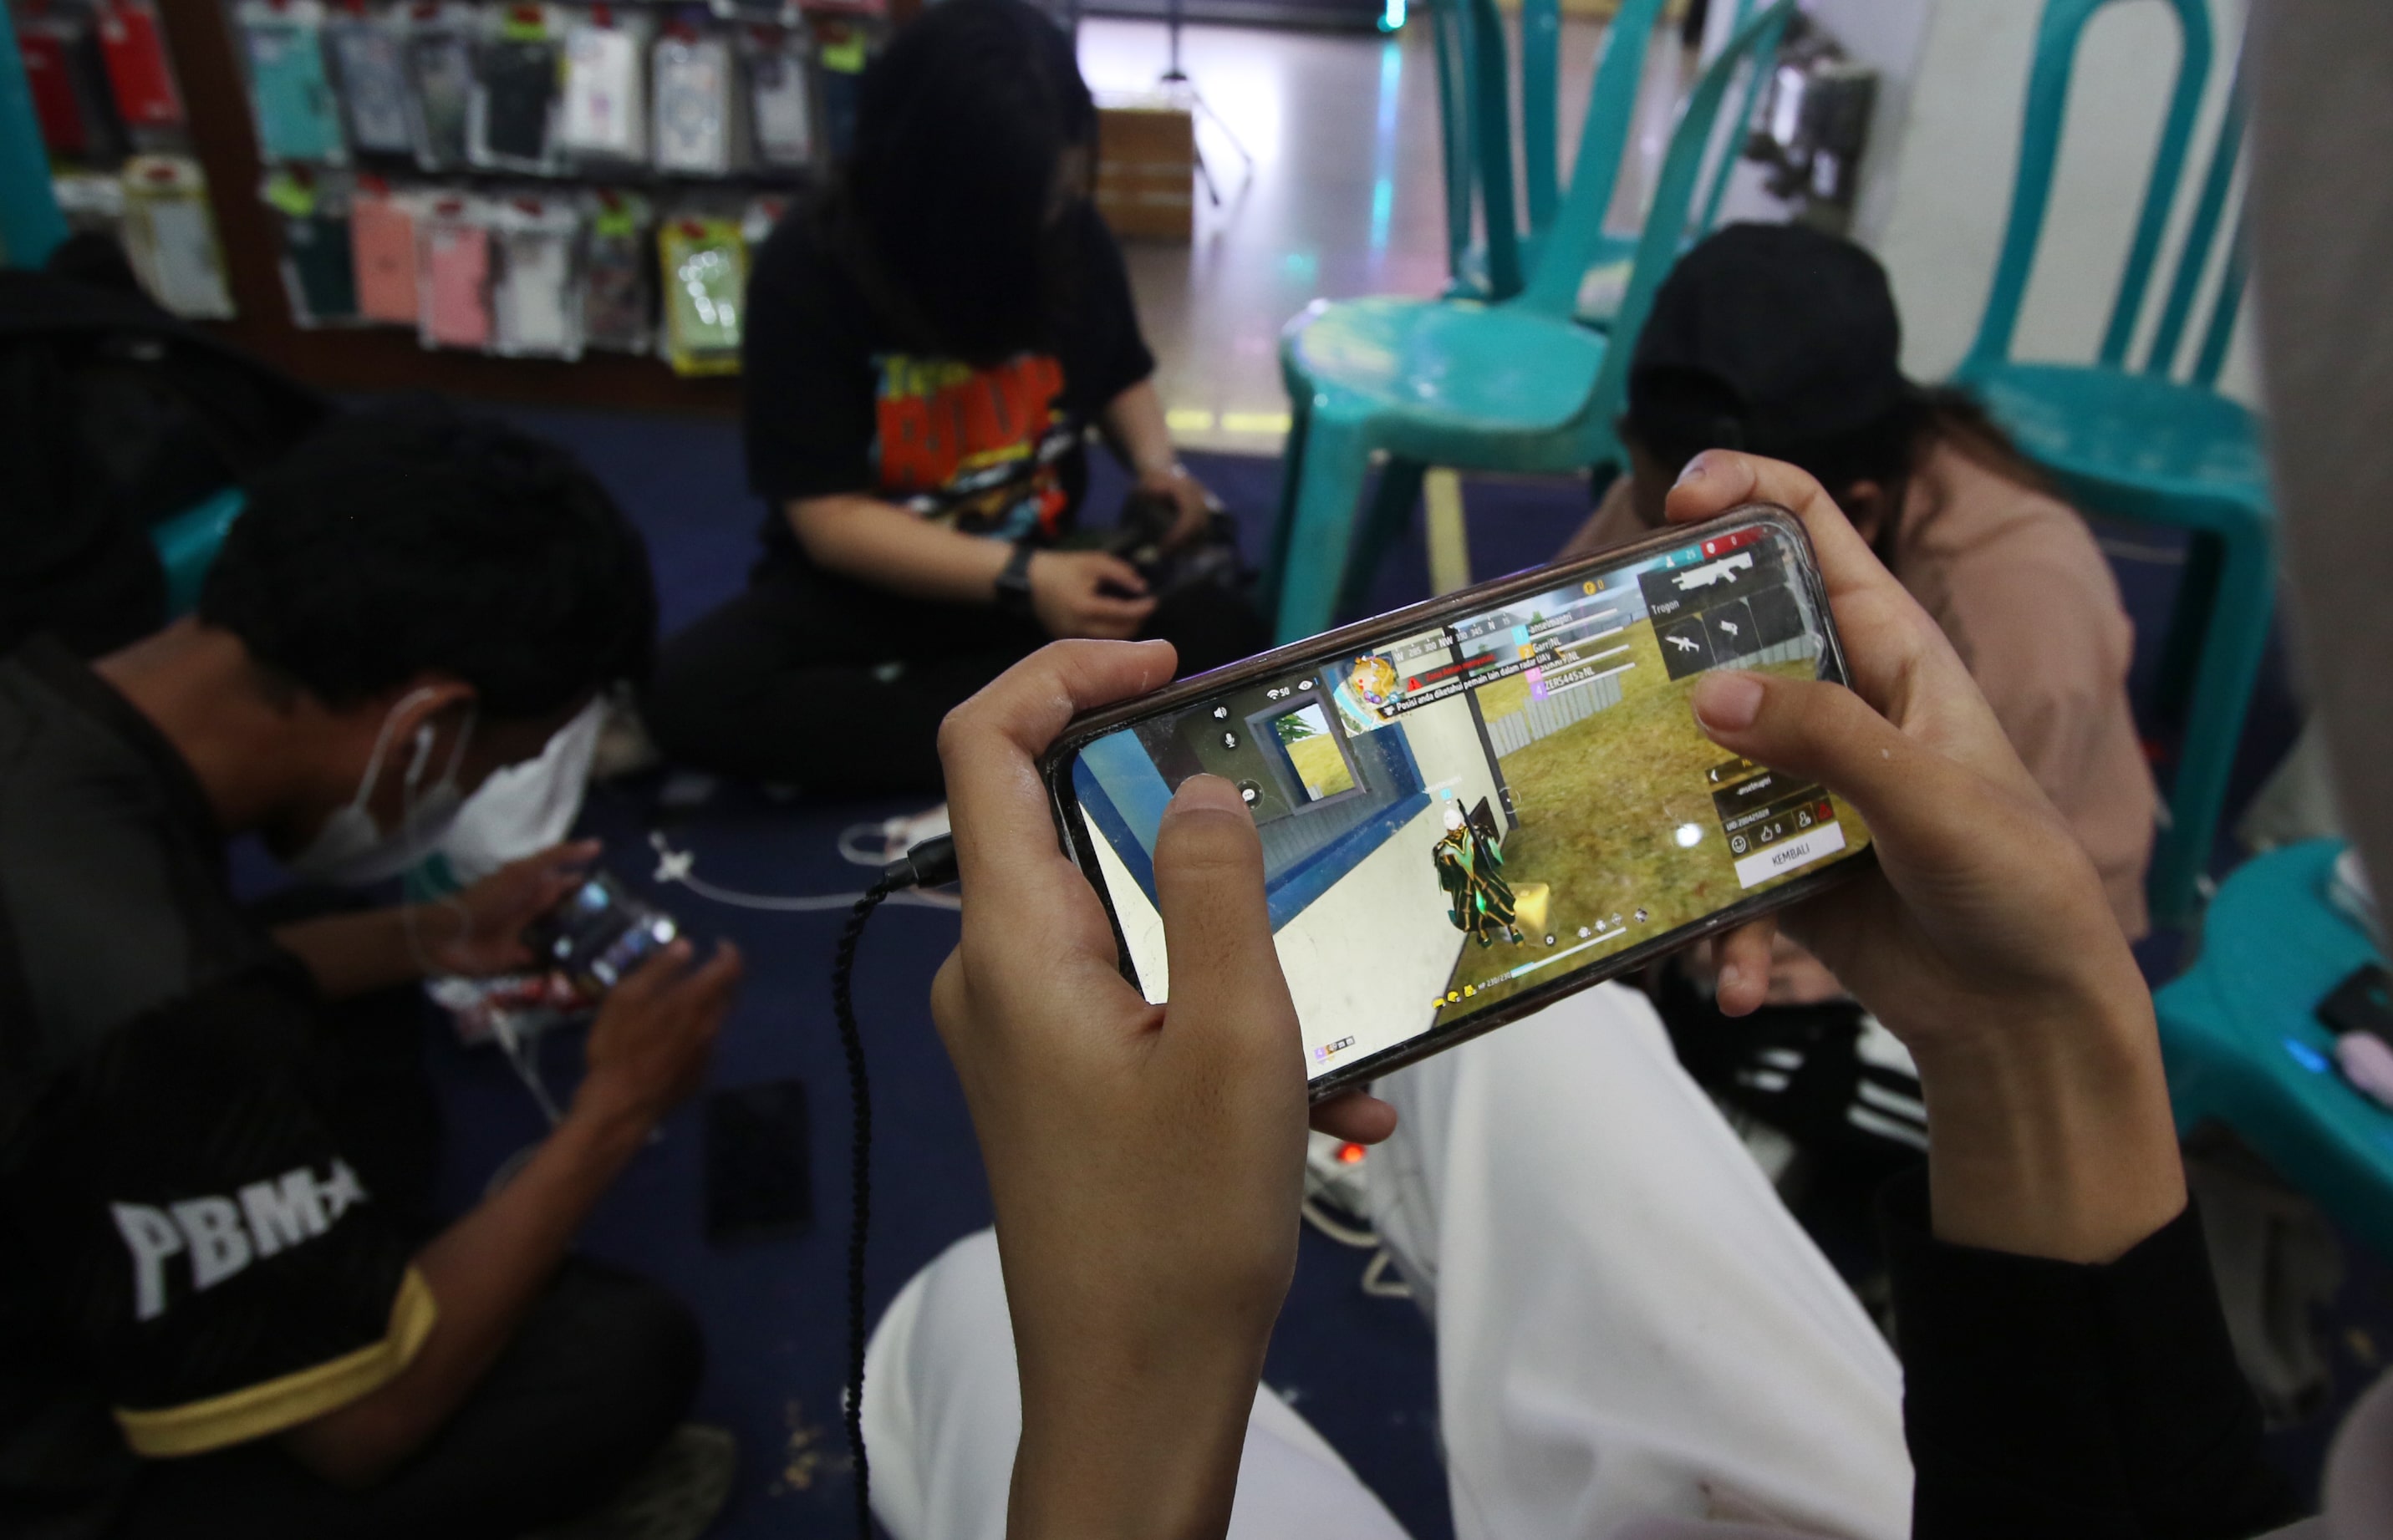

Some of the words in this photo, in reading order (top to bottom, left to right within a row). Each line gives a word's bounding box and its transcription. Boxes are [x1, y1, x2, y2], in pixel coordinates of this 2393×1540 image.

[1651, 600, 1680, 616] Trogon
[1438, 637, 1453, 650] NW
[1488, 620, 1495, 631] N
[1397, 696, 1418, 711] Posisi
[1418, 693, 1433, 705] anda
[1434, 683, 1464, 701] diketahui
[1464, 675, 1487, 691] pemain
[1488, 671, 1500, 683] lain
[1500, 664, 1519, 679] dalam
[1520, 659, 1535, 673] radar
[1536, 653, 1550, 665] UAV
[1772, 842, 1810, 867] KEMBALI
